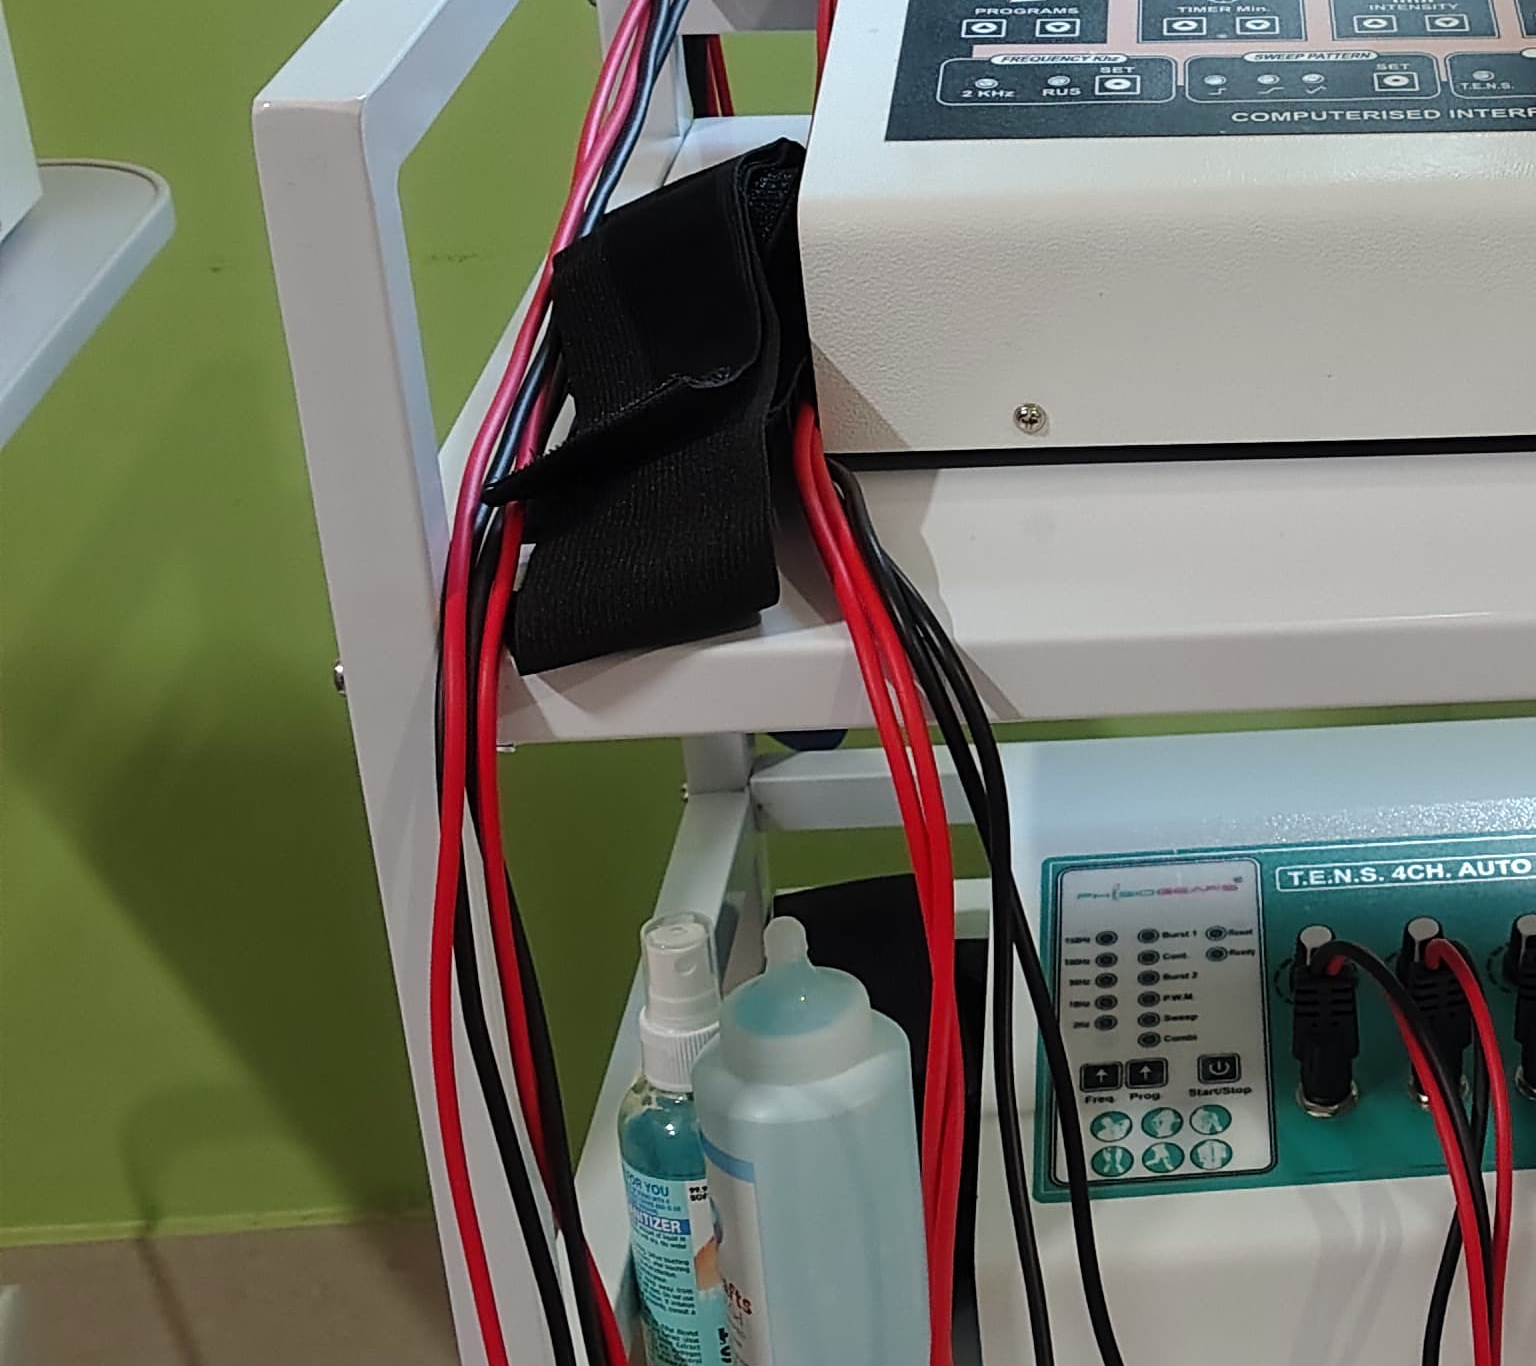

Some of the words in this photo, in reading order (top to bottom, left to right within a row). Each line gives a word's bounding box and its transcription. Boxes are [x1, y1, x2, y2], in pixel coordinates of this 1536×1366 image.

[974, 6, 1079, 15] PROGRAMS
[1176, 6, 1232, 14] TIMER
[1235, 5, 1271, 13] Min.
[1369, 2, 1459, 11] INTENSITY
[1000, 55, 1087, 63] FREQUENCY
[1093, 54, 1120, 62] Khz
[1307, 52, 1372, 60] PATTERN
[1460, 82, 1515, 90] T.E.N.S.
[1042, 88, 1081, 96] RUS
[1231, 109, 1441, 123] COMPUTERISED
[1287, 866, 1385, 886] T.E.N.S.
[1392, 862, 1451, 880] 4CH.
[1458, 857, 1532, 877] AUTO
[1189, 1086, 1253, 1098] Start/Stop
[644, 1181, 670, 1197] YOU
